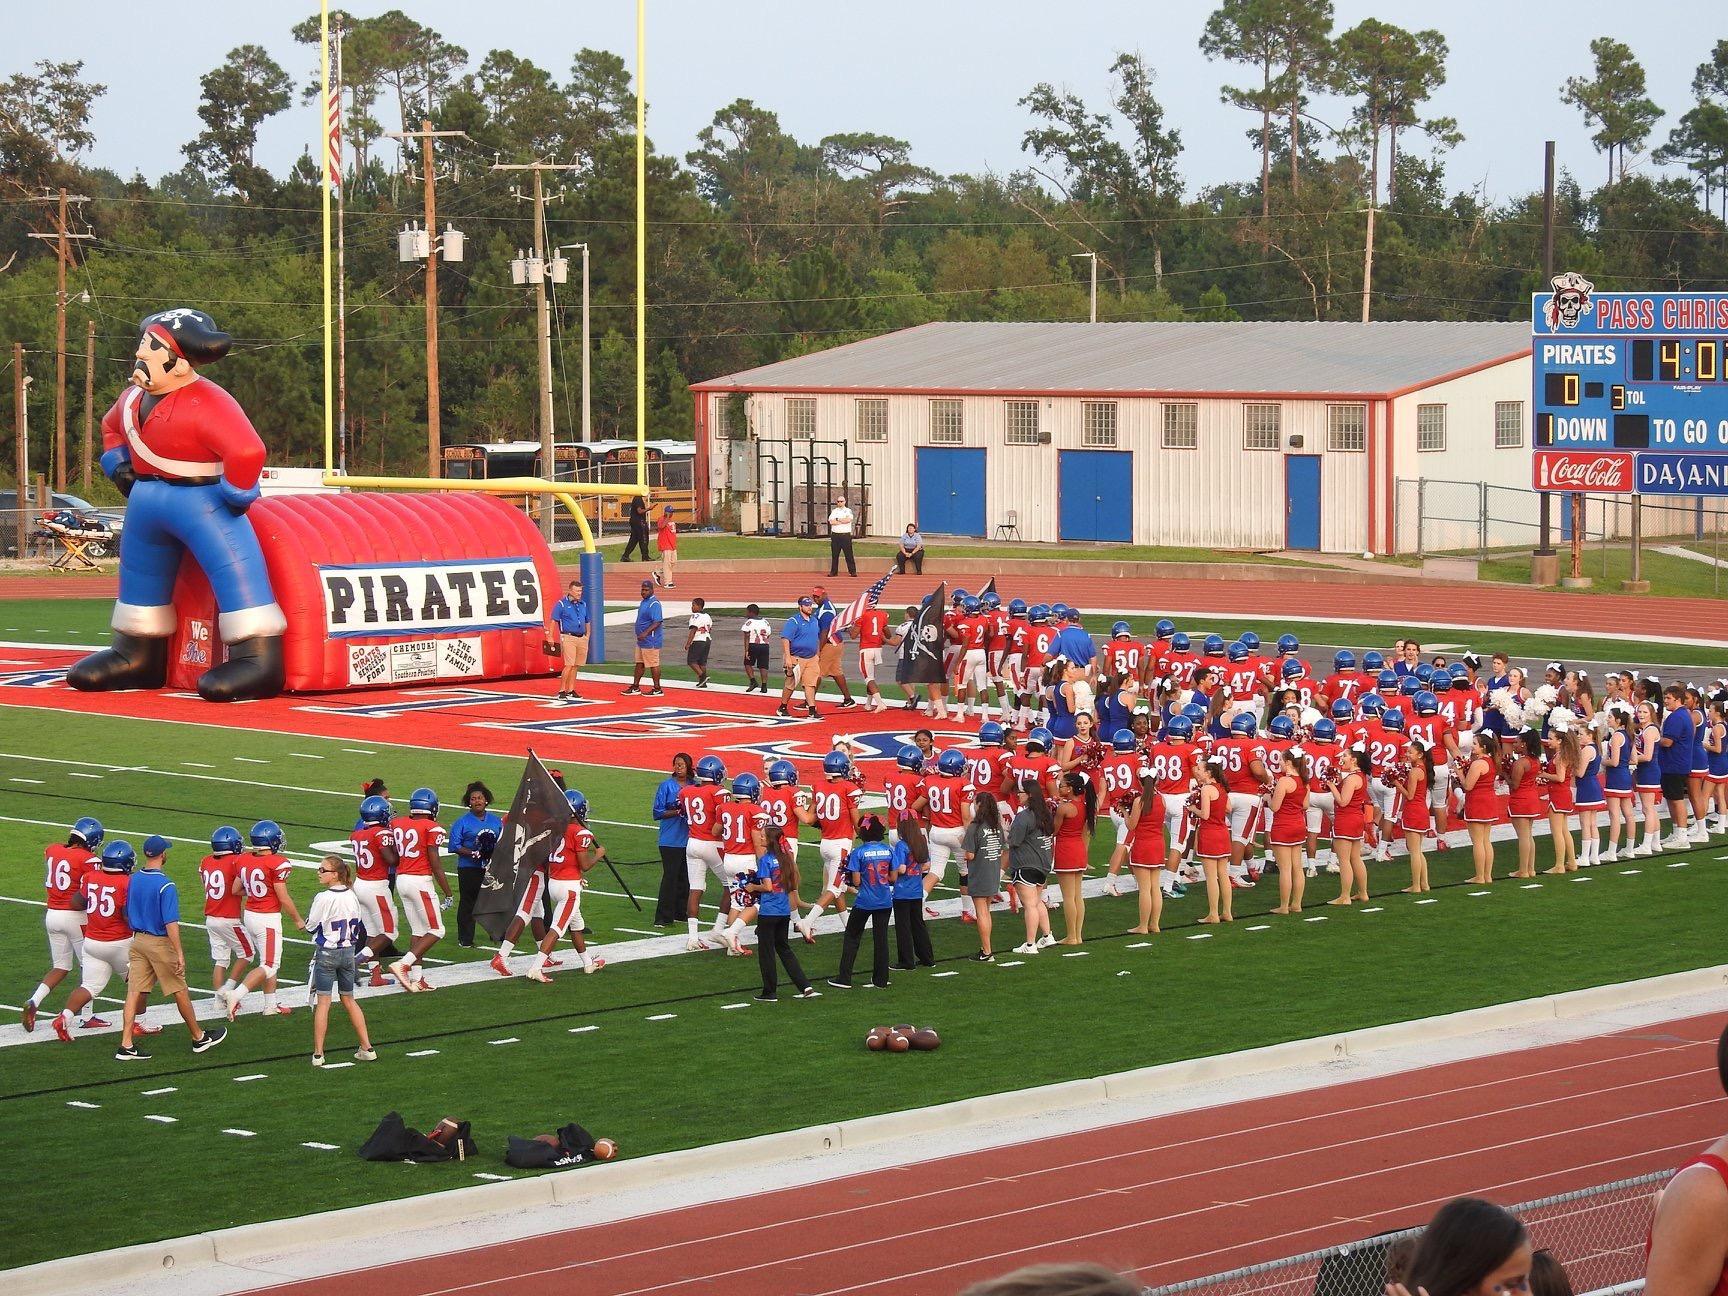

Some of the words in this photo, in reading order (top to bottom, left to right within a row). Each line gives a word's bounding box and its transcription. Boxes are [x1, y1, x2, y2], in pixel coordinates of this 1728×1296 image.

[1597, 299, 1654, 329] PASS
[1663, 299, 1728, 330] CHRIS
[1543, 344, 1616, 365] PIRATES
[1564, 375, 1579, 405] 0
[1626, 391, 1646, 405] TOL
[1557, 417, 1607, 441] DOWN
[1653, 419, 1676, 443] TO
[1683, 419, 1708, 443] GO
[1551, 456, 1626, 487] Coca-Cola
[326, 568, 540, 624] PIRATES
[191, 620, 209, 641] We
[871, 616, 879, 636] 1
[975, 624, 985, 644] 2
[352, 647, 365, 660] GO
[393, 641, 435, 653] CHEMOURS
[457, 639, 472, 653] THE
[1036, 633, 1049, 654] 6
[352, 646, 381, 672] PIRATES
[444, 654, 471, 674] FAMILY
[1115, 648, 1139, 671] 50
[366, 663, 386, 682] FORD
[394, 669, 417, 680] Southern
[1171, 661, 1194, 684] 27
[1230, 670, 1256, 693] 47
[1409, 723, 1434, 749] 61
[1216, 745, 1242, 772] 65
[1370, 740, 1397, 767] 22
[968, 757, 992, 785] 79
[1103, 763, 1133, 792] 59
[1154, 754, 1182, 781] 88
[684, 796, 707, 826] 13
[815, 791, 841, 821] 20
[928, 785, 953, 814] 81
[722, 811, 747, 844] 31
[393, 827, 420, 859] 82
[580, 836, 591, 848] 12
[45, 856, 71, 891] 16
[241, 866, 268, 898] 46
[86, 882, 117, 918] 55
